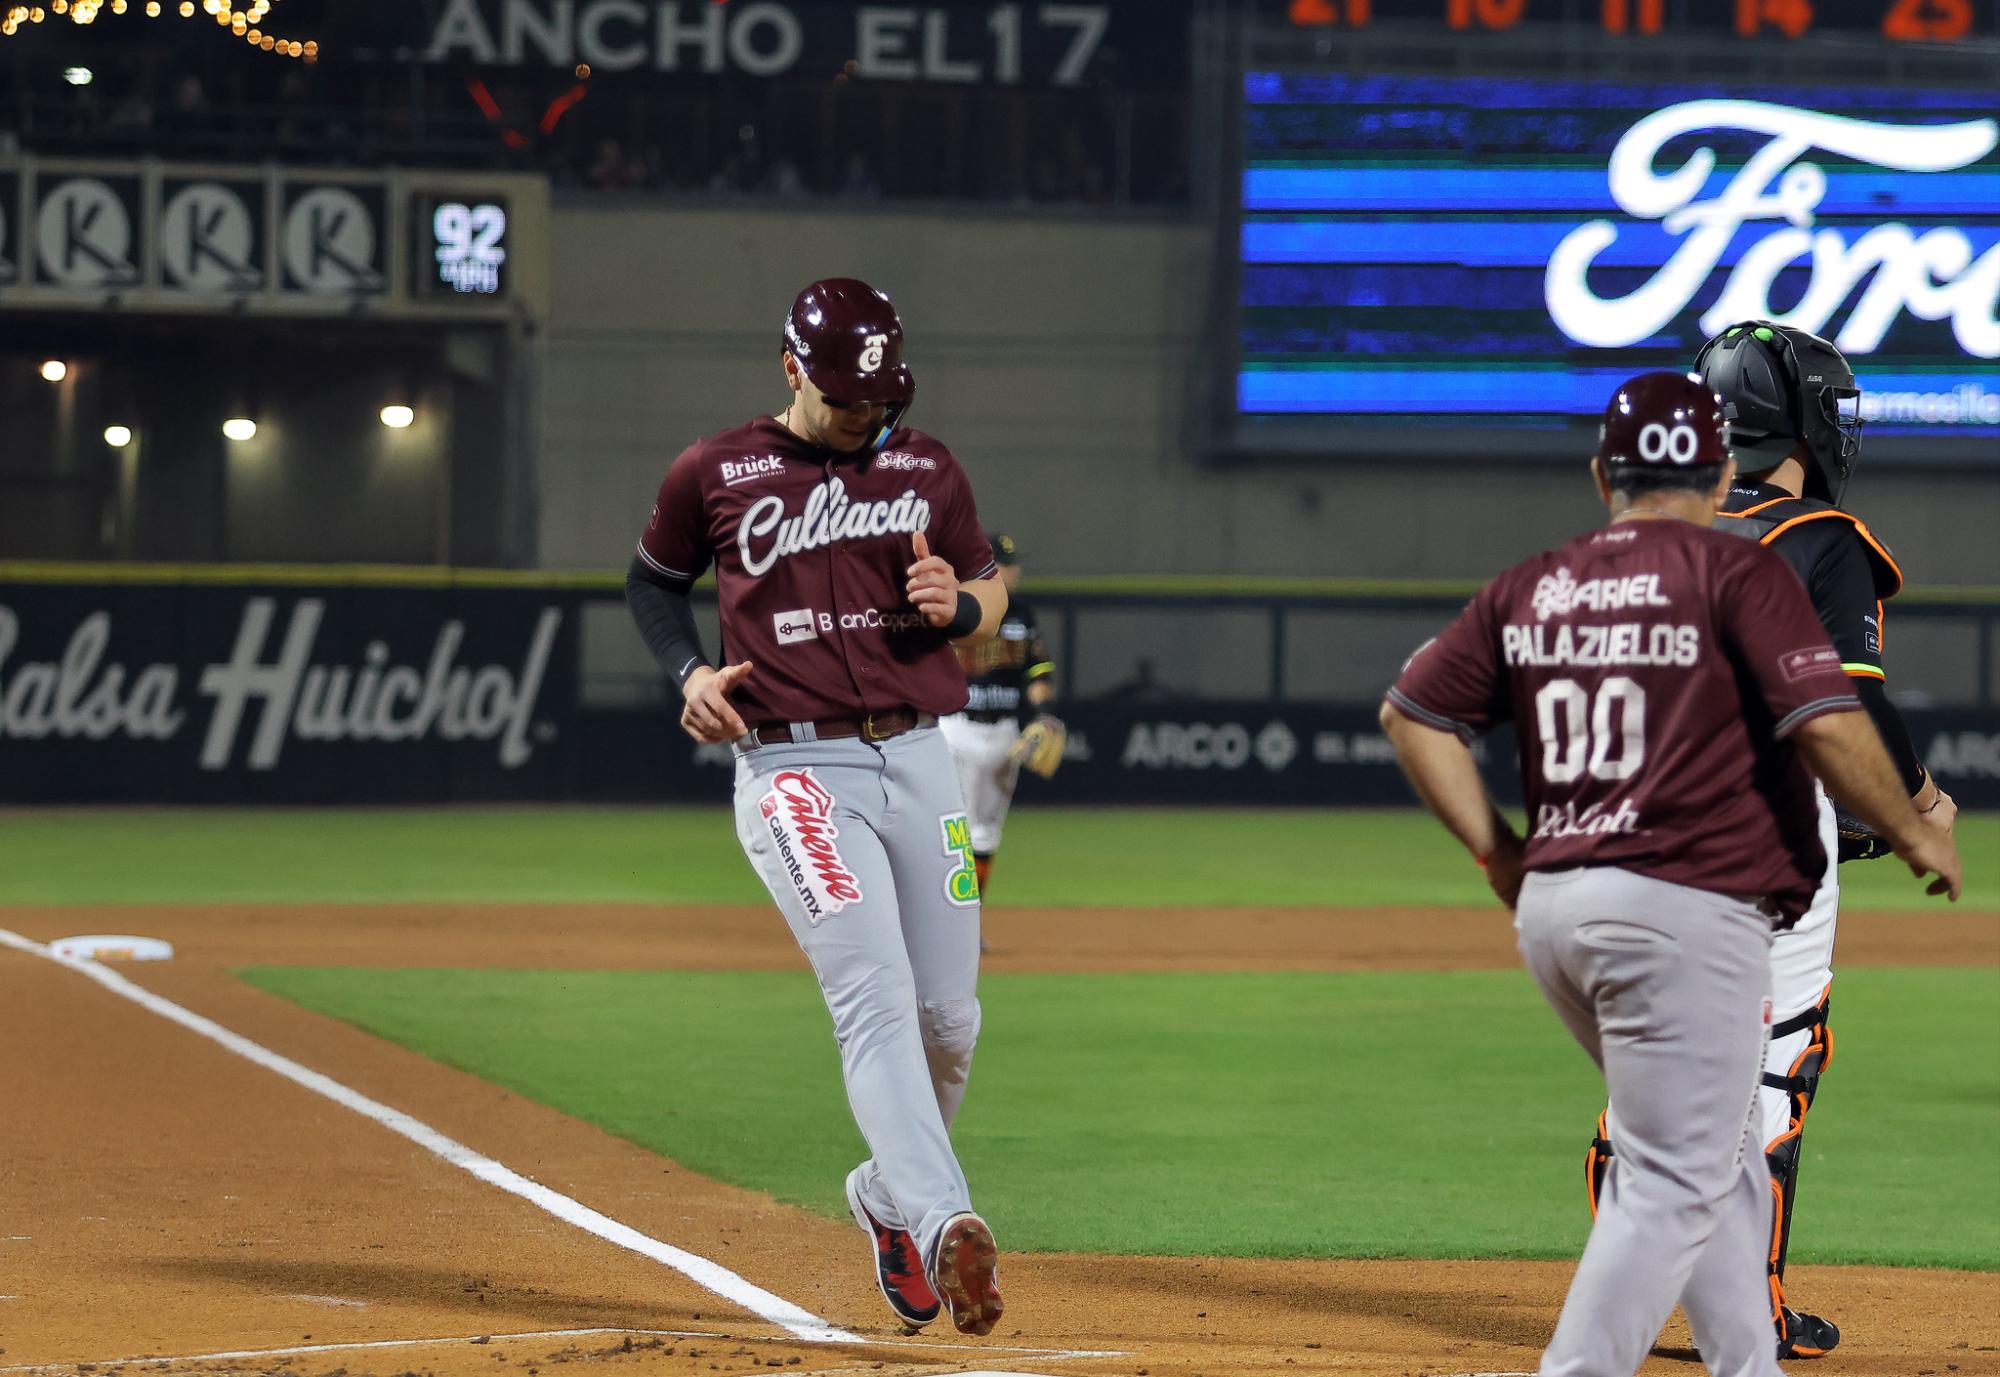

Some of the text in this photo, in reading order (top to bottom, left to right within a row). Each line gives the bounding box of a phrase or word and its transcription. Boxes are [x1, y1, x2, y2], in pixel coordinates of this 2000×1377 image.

[434, 203, 505, 262] 92
[876, 451, 935, 470] SuKarne
[1638, 423, 1697, 463] 00
[721, 455, 785, 480] Brück
[1573, 573, 1671, 611] ARIEL
[1503, 623, 1699, 666] PALAZUELOS
[201, 598, 562, 769] Huichol
[1123, 723, 1251, 768] ARCO
[1536, 677, 1645, 783] 00
[774, 767, 860, 901] Caliente
[769, 815, 822, 918] caliente.mx
